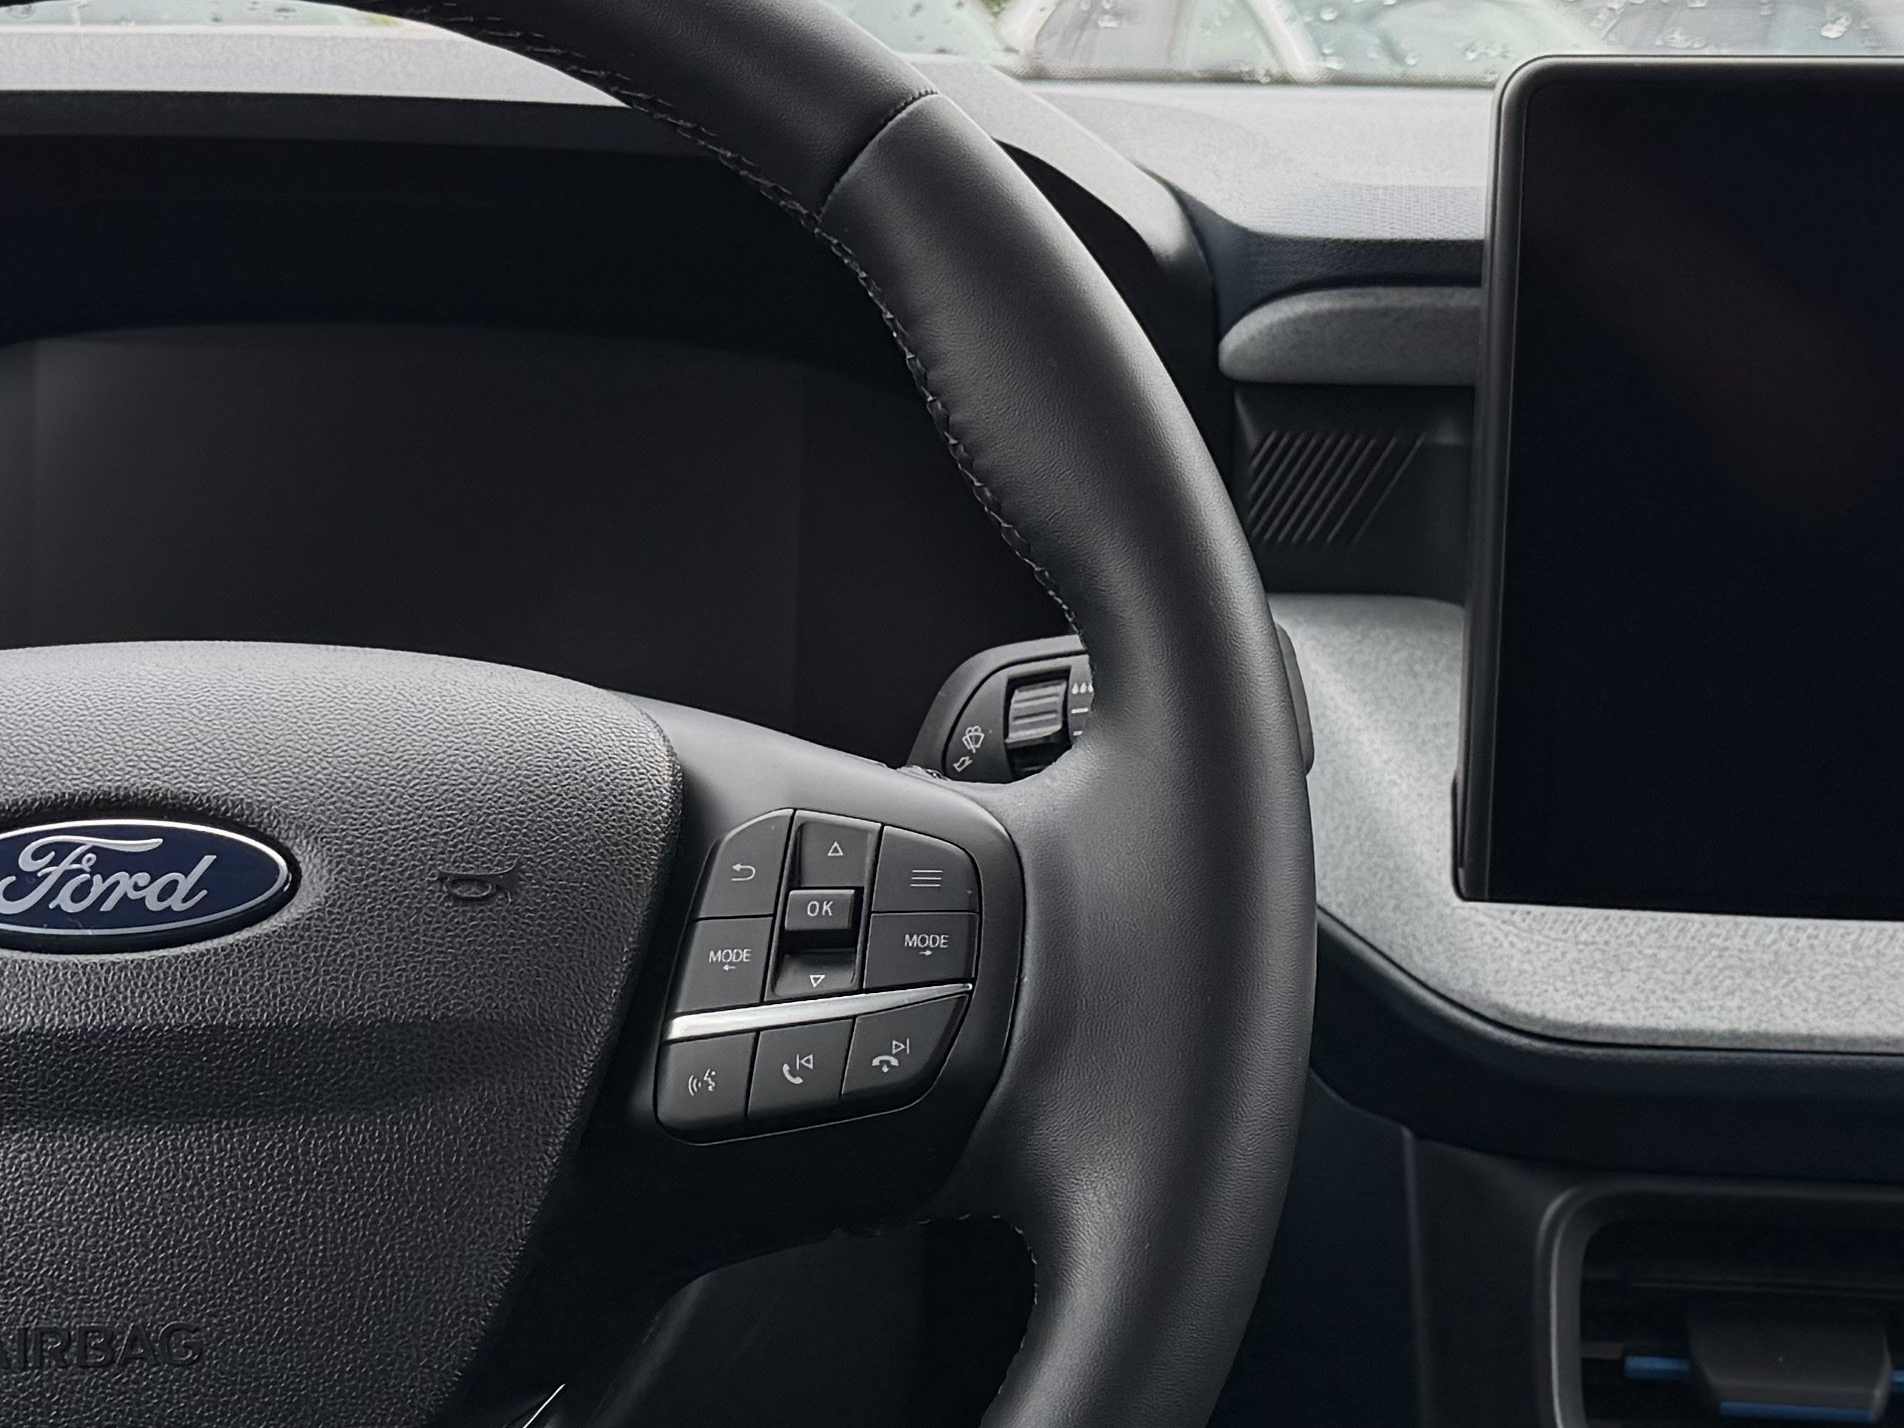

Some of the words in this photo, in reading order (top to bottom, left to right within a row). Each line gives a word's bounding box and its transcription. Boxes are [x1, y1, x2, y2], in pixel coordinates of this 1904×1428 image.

[806, 900, 834, 918] OK
[903, 933, 950, 949] MODE
[708, 948, 752, 964] MODE
